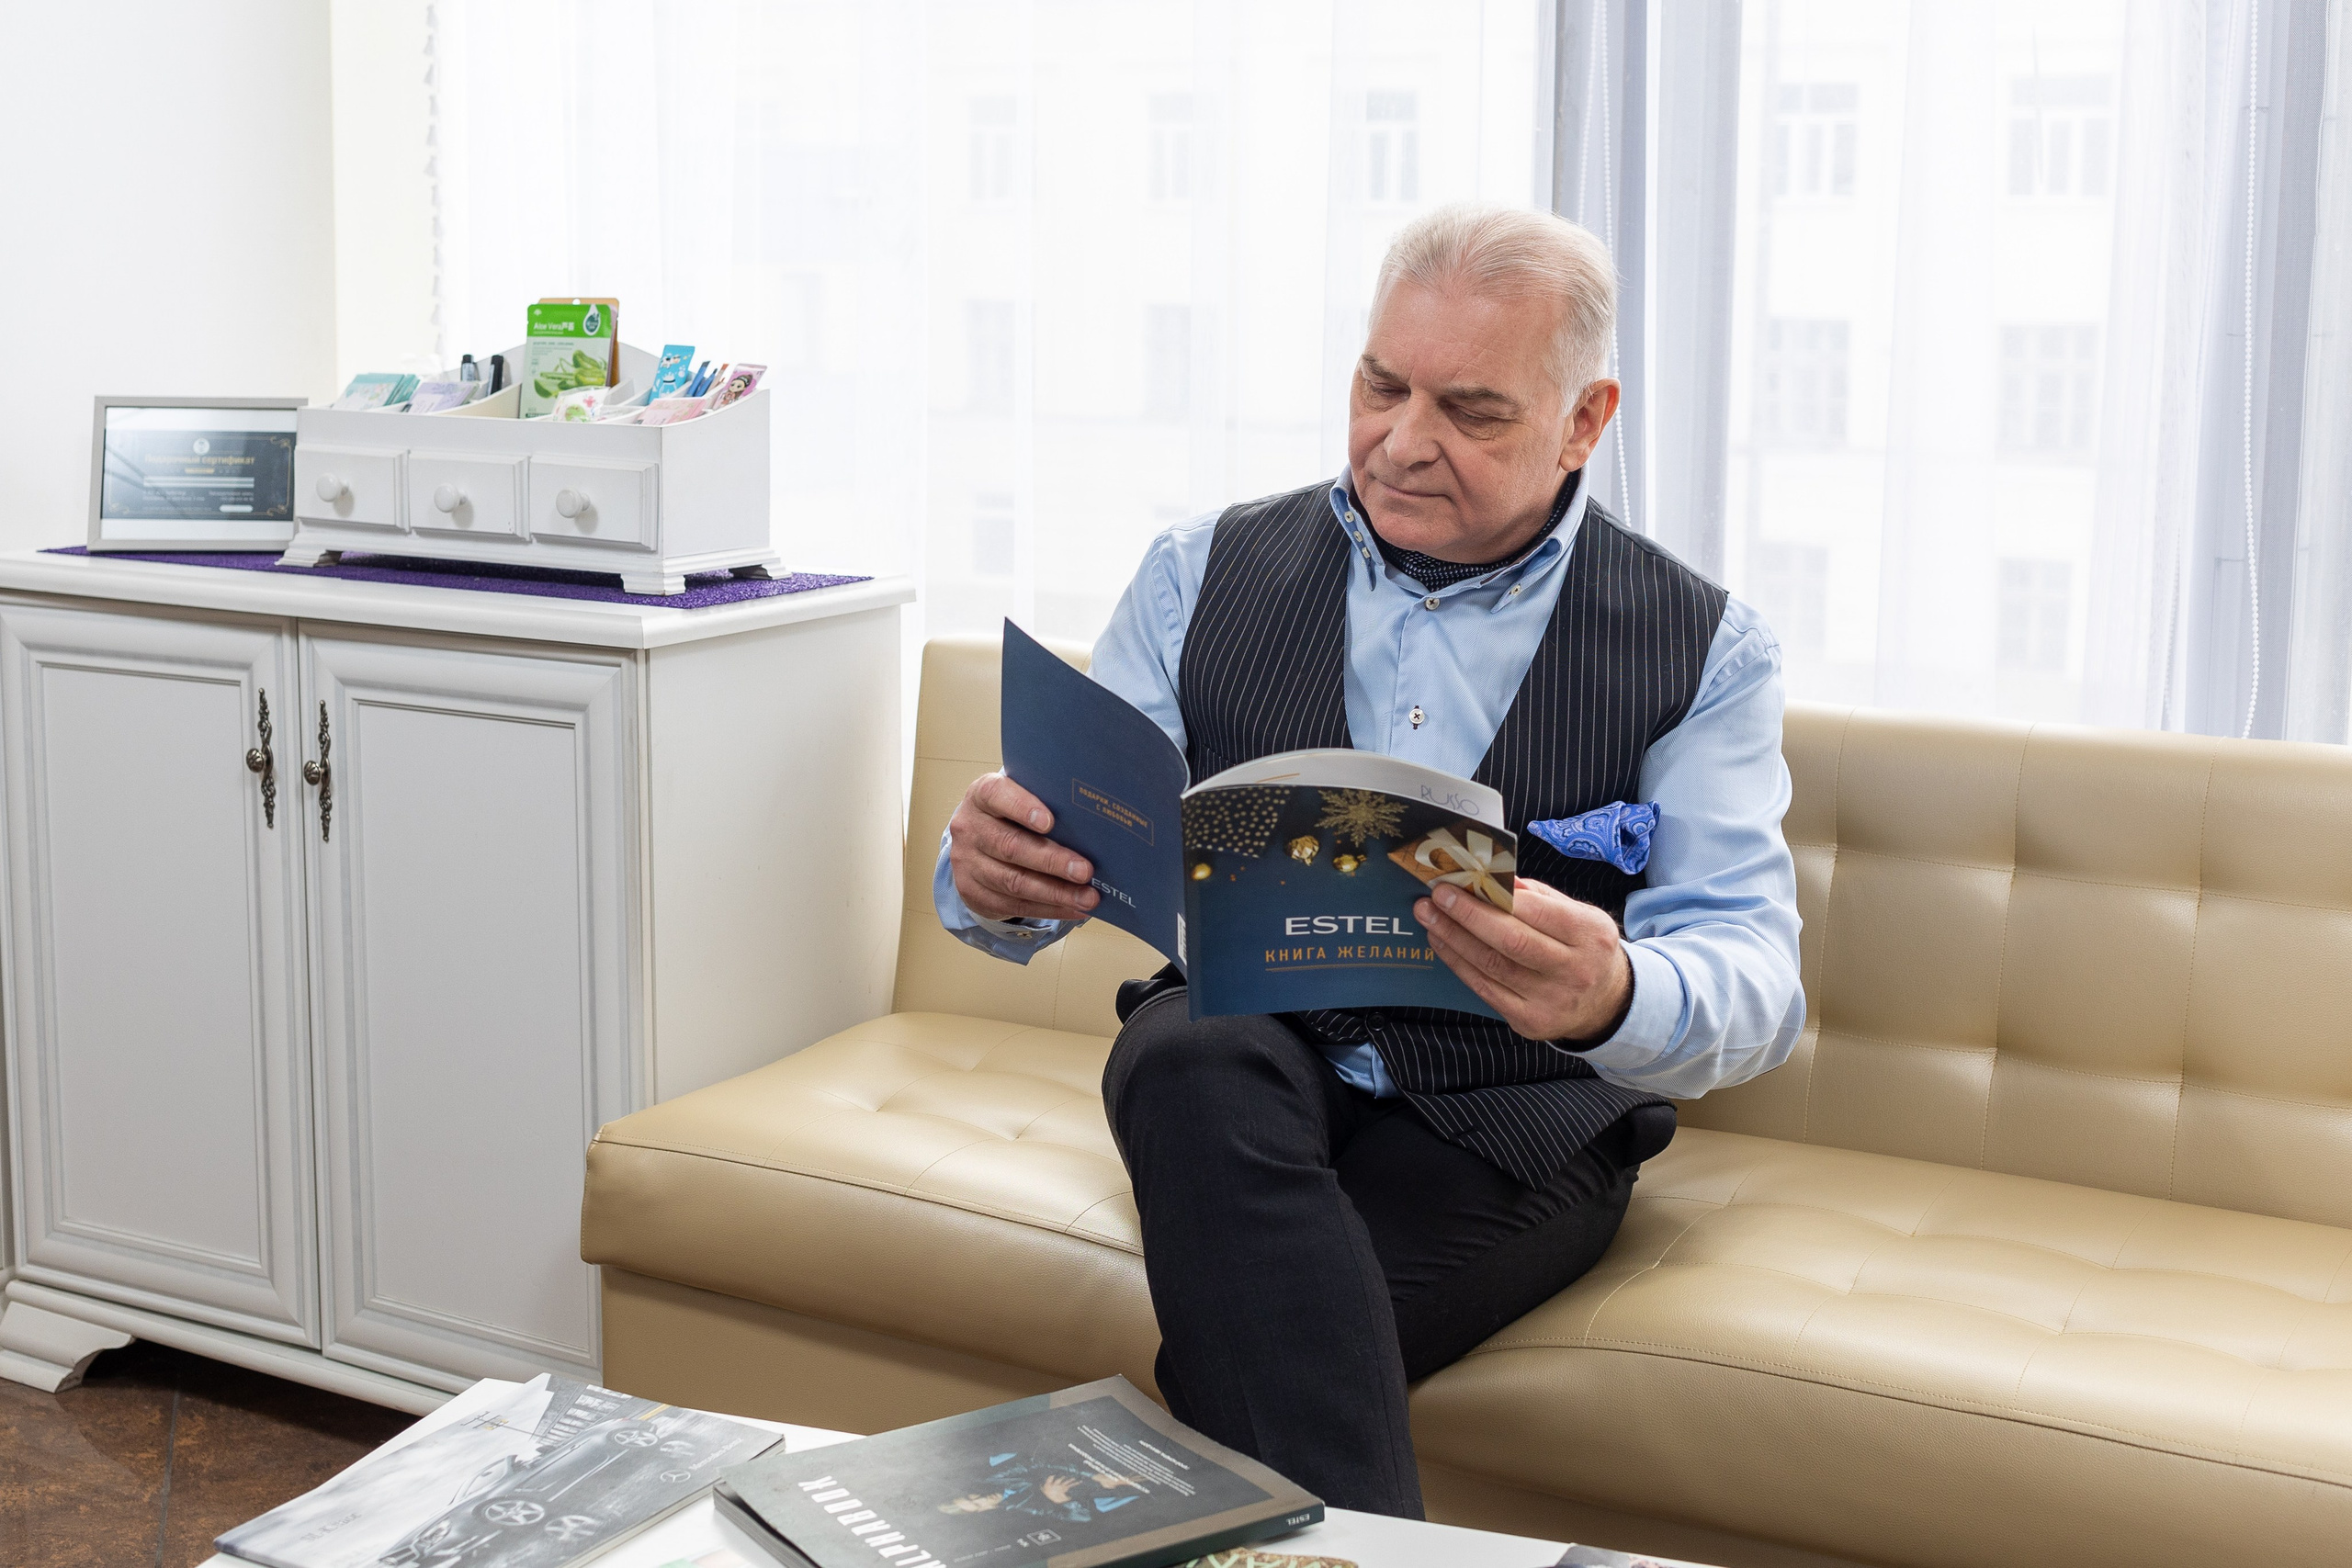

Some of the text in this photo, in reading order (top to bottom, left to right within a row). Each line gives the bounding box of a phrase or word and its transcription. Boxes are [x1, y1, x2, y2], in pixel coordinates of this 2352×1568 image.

[1091, 877, 1136, 908] ESTEL
[1285, 916, 1414, 935] ESTEL
[1265, 945, 1435, 963] КНИГА ЖЕЛАНИЙ
